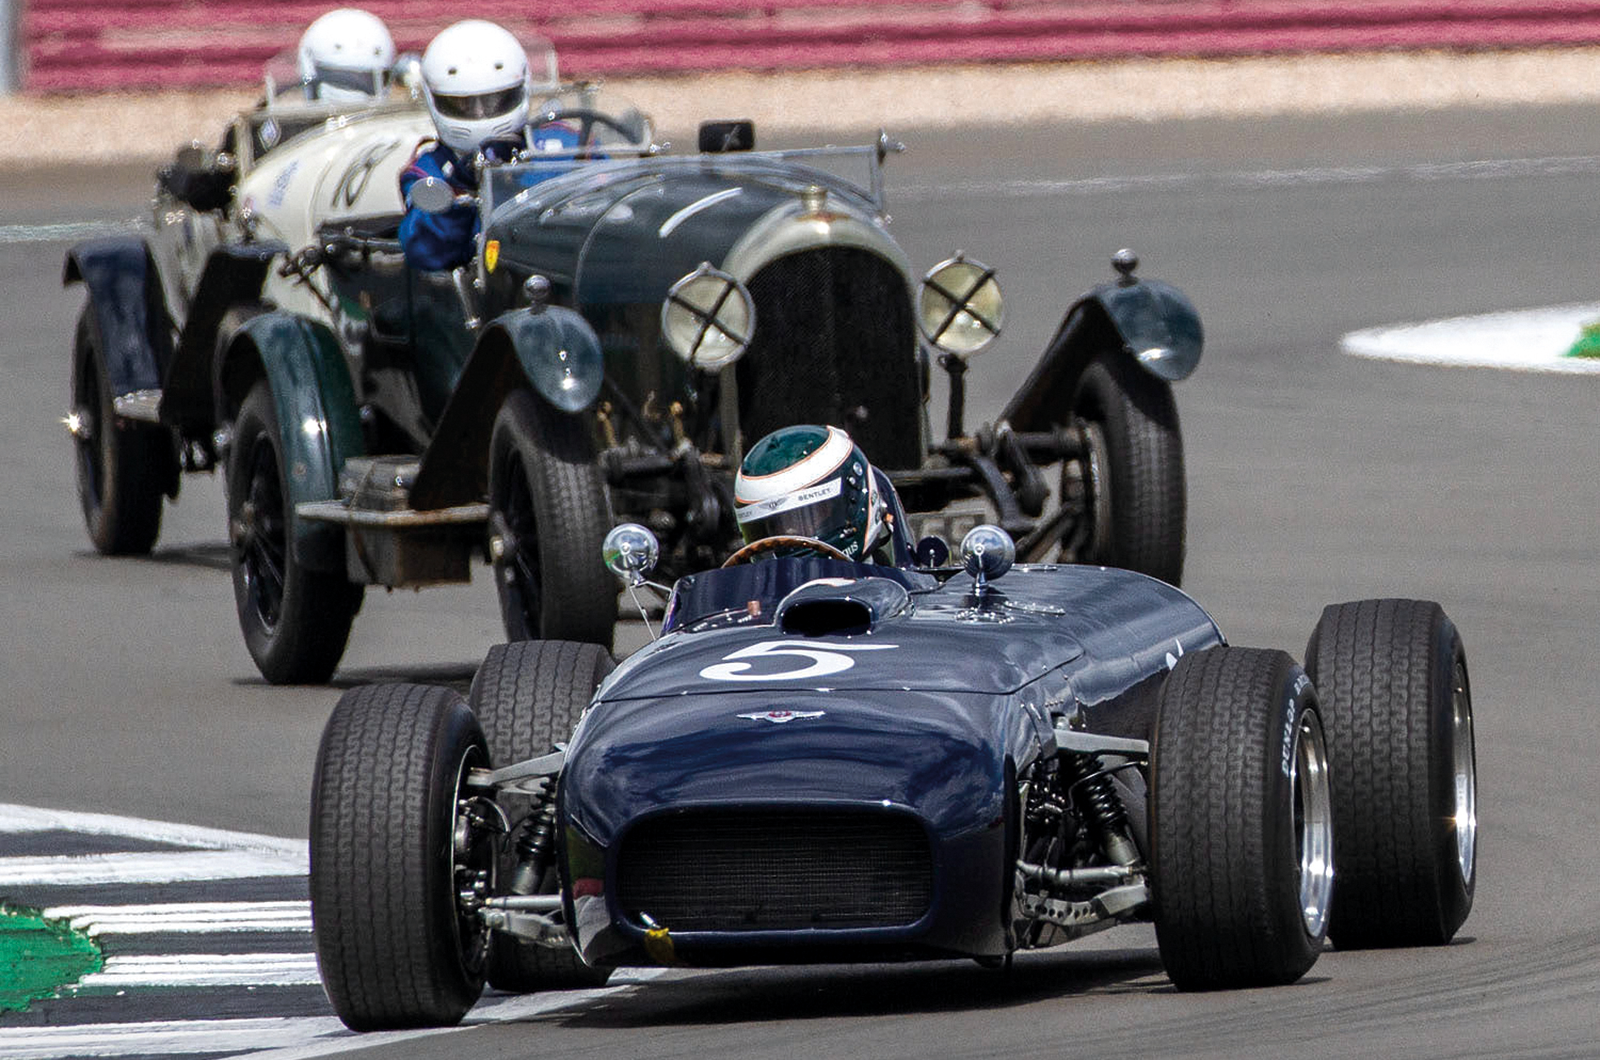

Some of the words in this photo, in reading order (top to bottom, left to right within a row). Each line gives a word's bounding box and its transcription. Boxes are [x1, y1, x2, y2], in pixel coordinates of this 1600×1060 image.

[798, 488, 831, 501] BENTLEY
[699, 640, 900, 682] 5
[1281, 698, 1296, 778] DUNLOP
